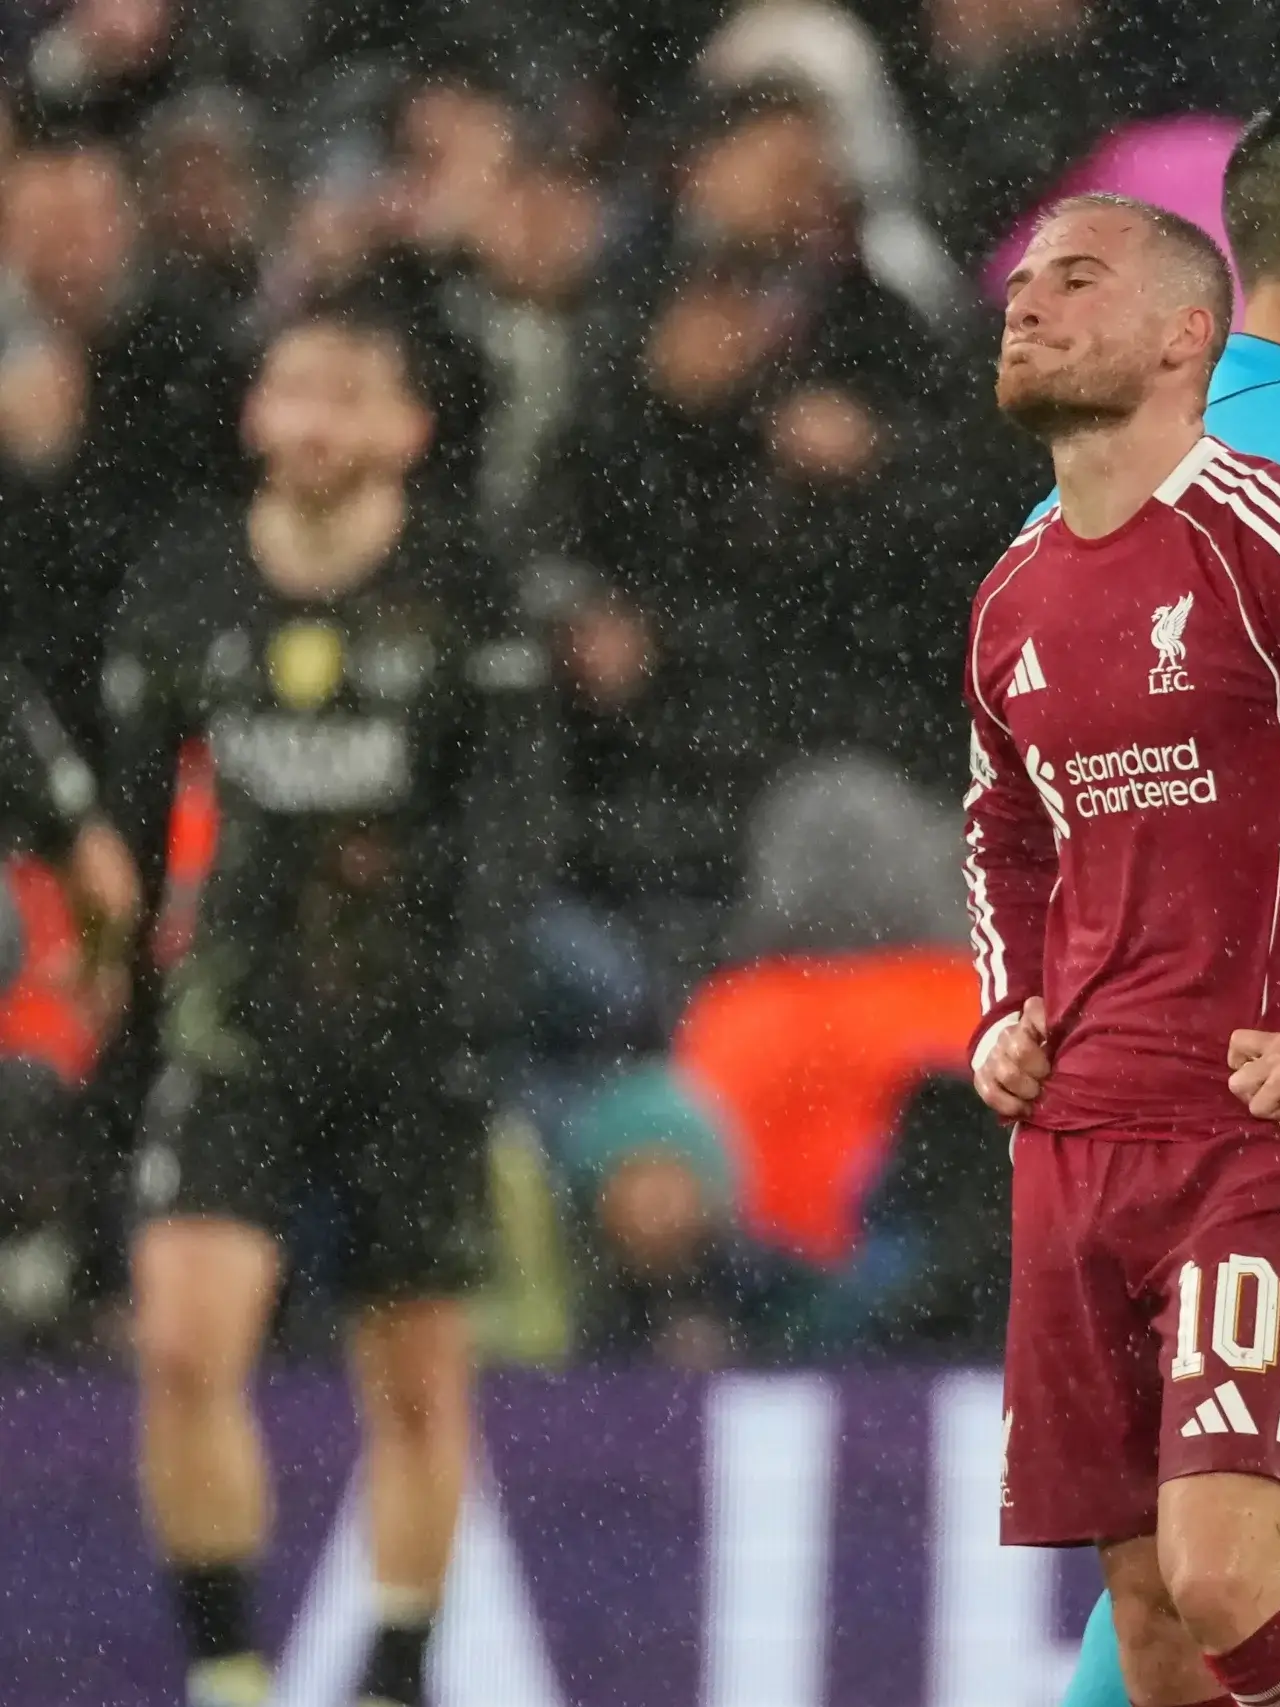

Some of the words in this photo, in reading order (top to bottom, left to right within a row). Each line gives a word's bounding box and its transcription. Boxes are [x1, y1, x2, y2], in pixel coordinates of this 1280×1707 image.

[1148, 671, 1195, 694] L.F.C.
[1065, 736, 1199, 786] standard
[1076, 769, 1217, 818] chartered
